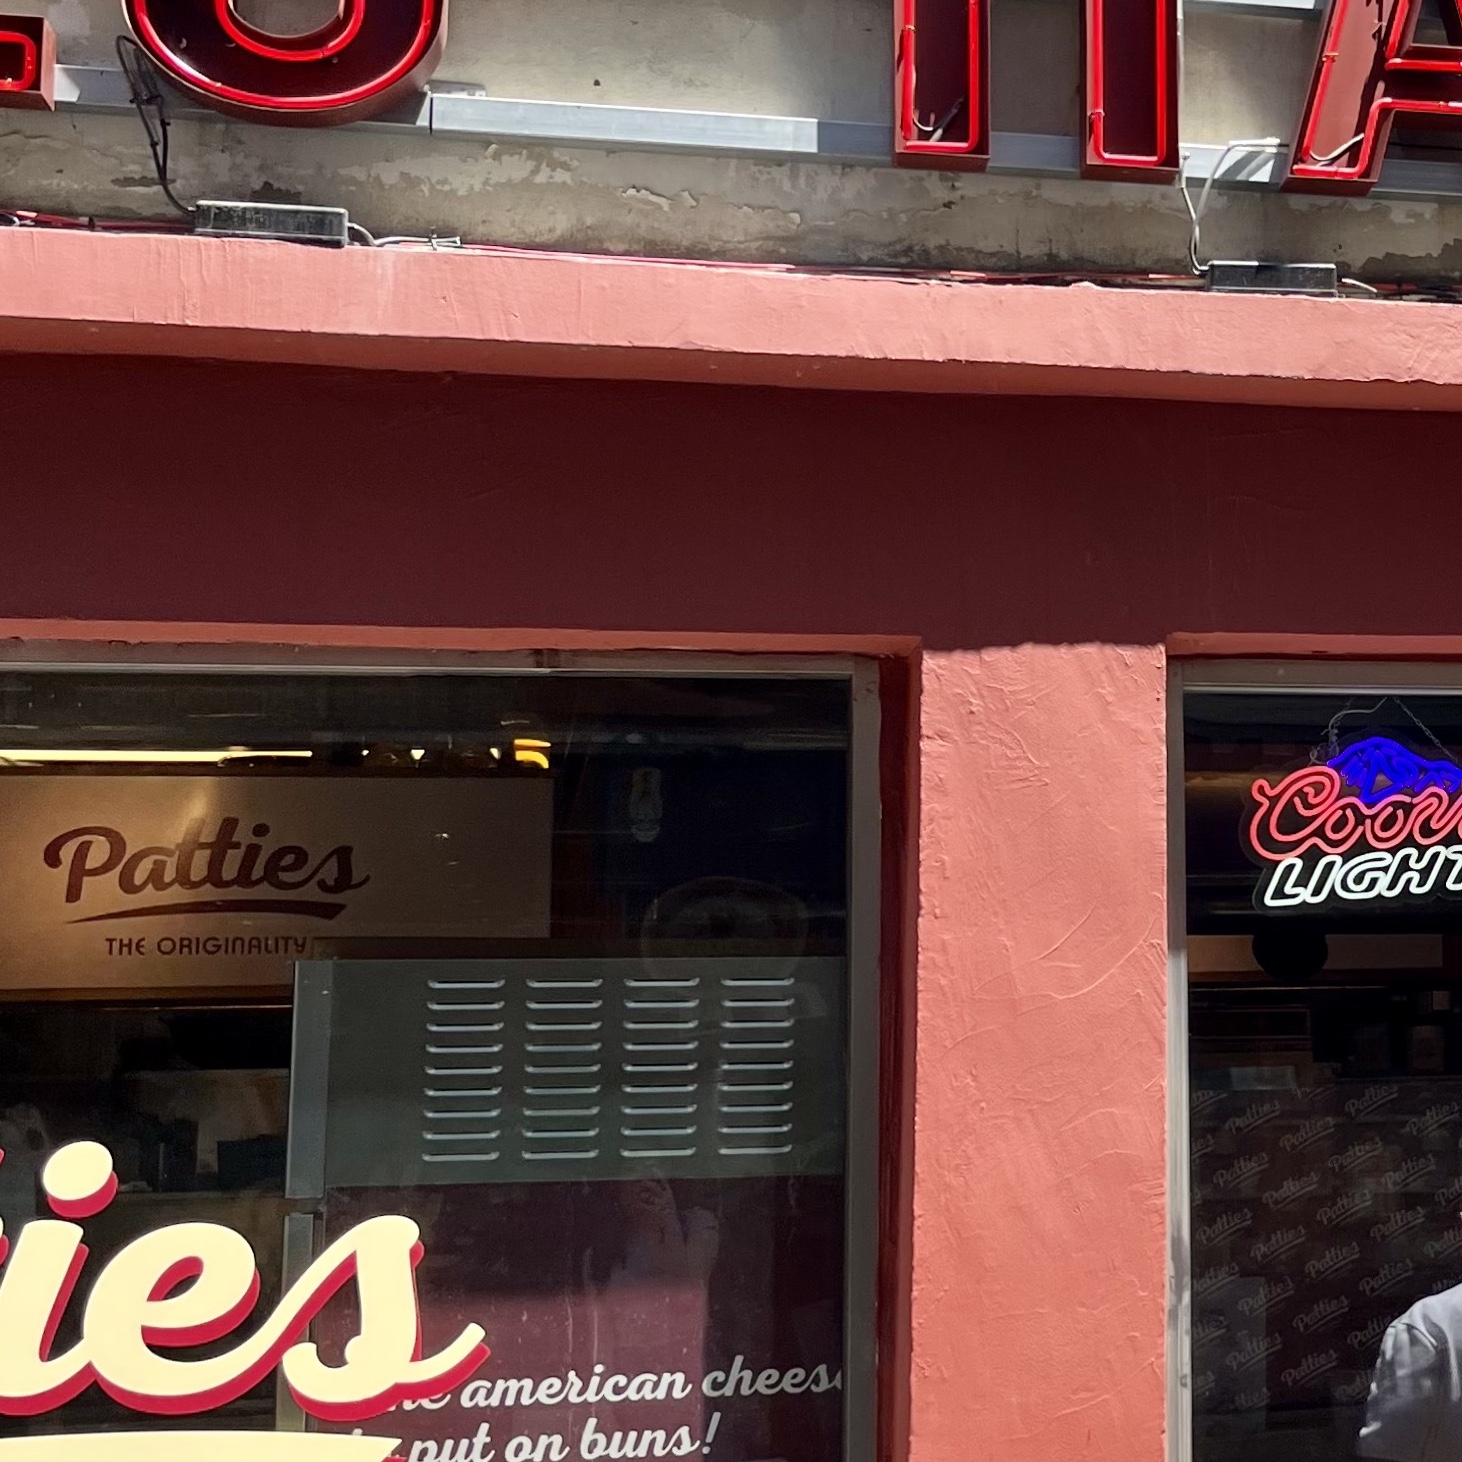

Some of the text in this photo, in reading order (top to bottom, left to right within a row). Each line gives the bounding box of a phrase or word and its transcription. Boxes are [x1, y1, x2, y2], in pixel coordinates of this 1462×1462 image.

[43, 816, 370, 904] Patties
[105, 936, 307, 956] THE ORIGINALITY
[0, 1140, 491, 1422] ies
[460, 1363, 693, 1409] american
[580, 1412, 722, 1460] buns!
